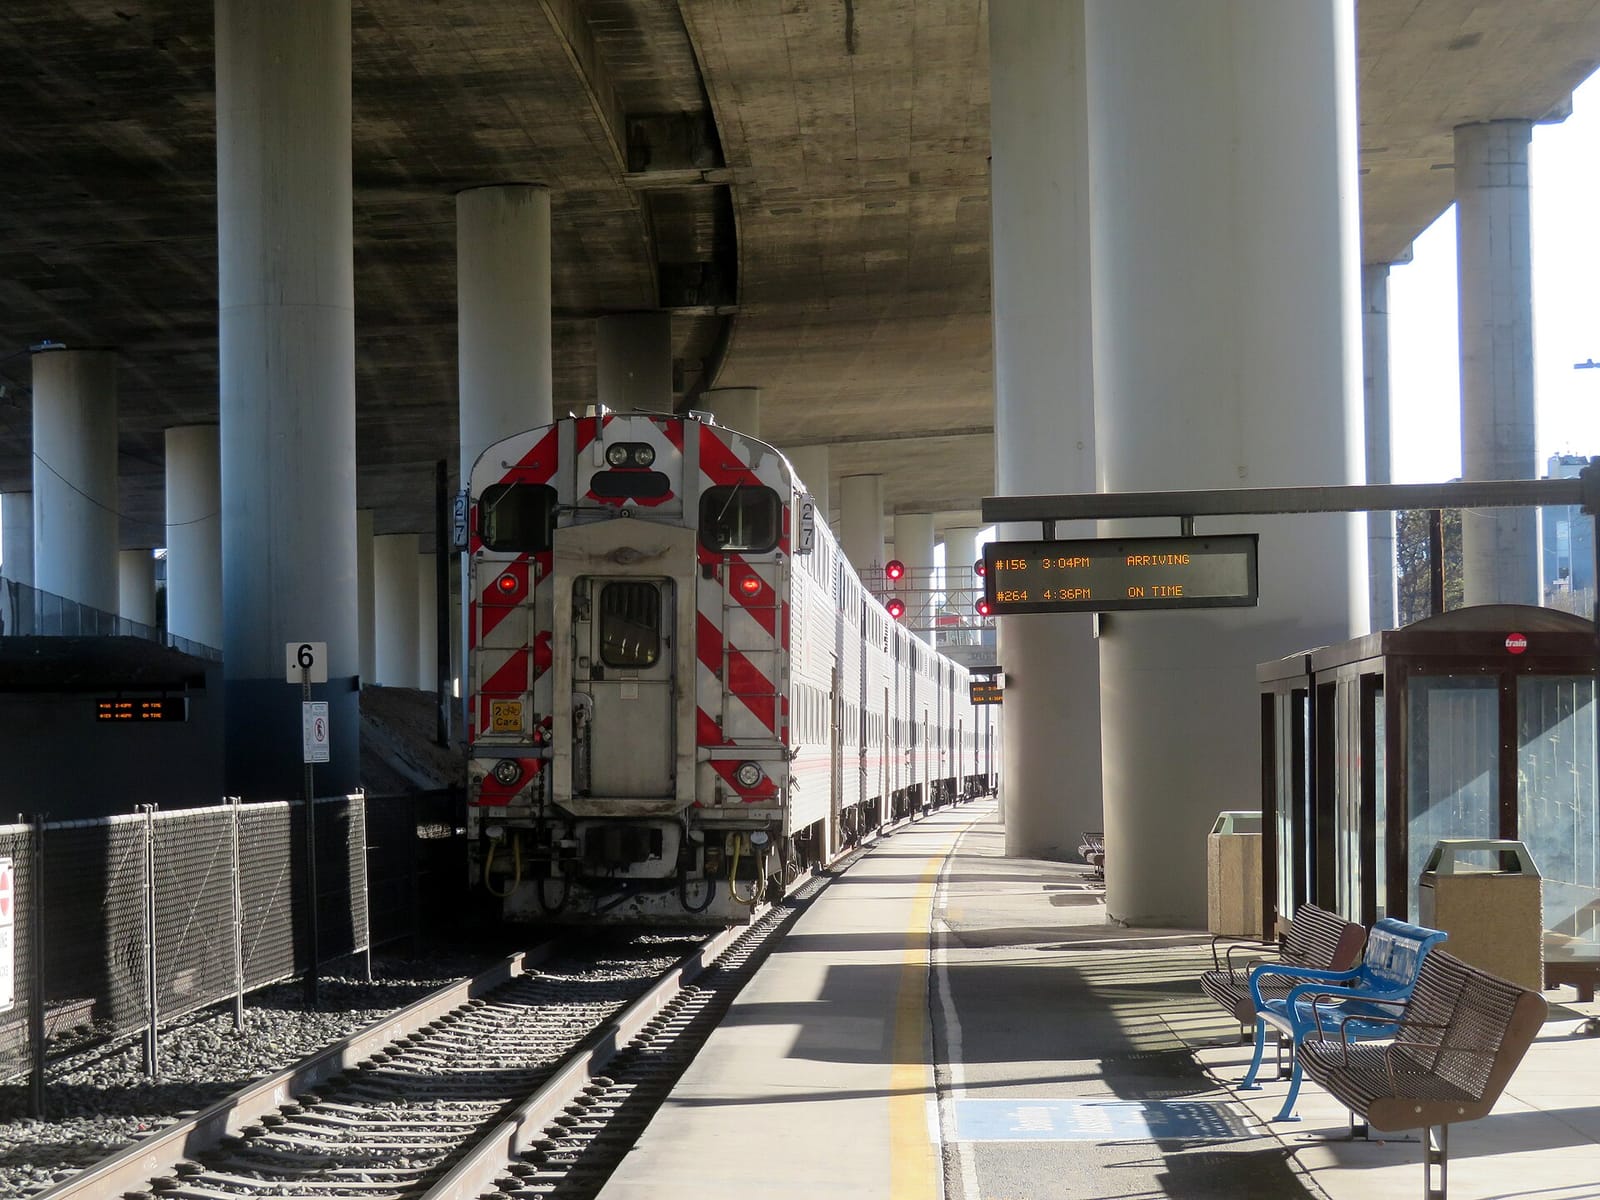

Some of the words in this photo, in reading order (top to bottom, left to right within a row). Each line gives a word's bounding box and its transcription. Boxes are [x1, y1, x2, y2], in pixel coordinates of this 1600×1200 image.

[802, 503, 813, 545] 27
[995, 559, 1028, 571] #156
[1042, 557, 1091, 569] 3:04PM
[1127, 554, 1190, 567] ARRIVING
[996, 590, 1028, 602] #264
[1043, 587, 1091, 600] 4:36PM
[1128, 587, 1144, 598] ON
[1152, 585, 1184, 597] TIME
[495, 706, 502, 716] 2
[496, 718, 519, 726] Cars
